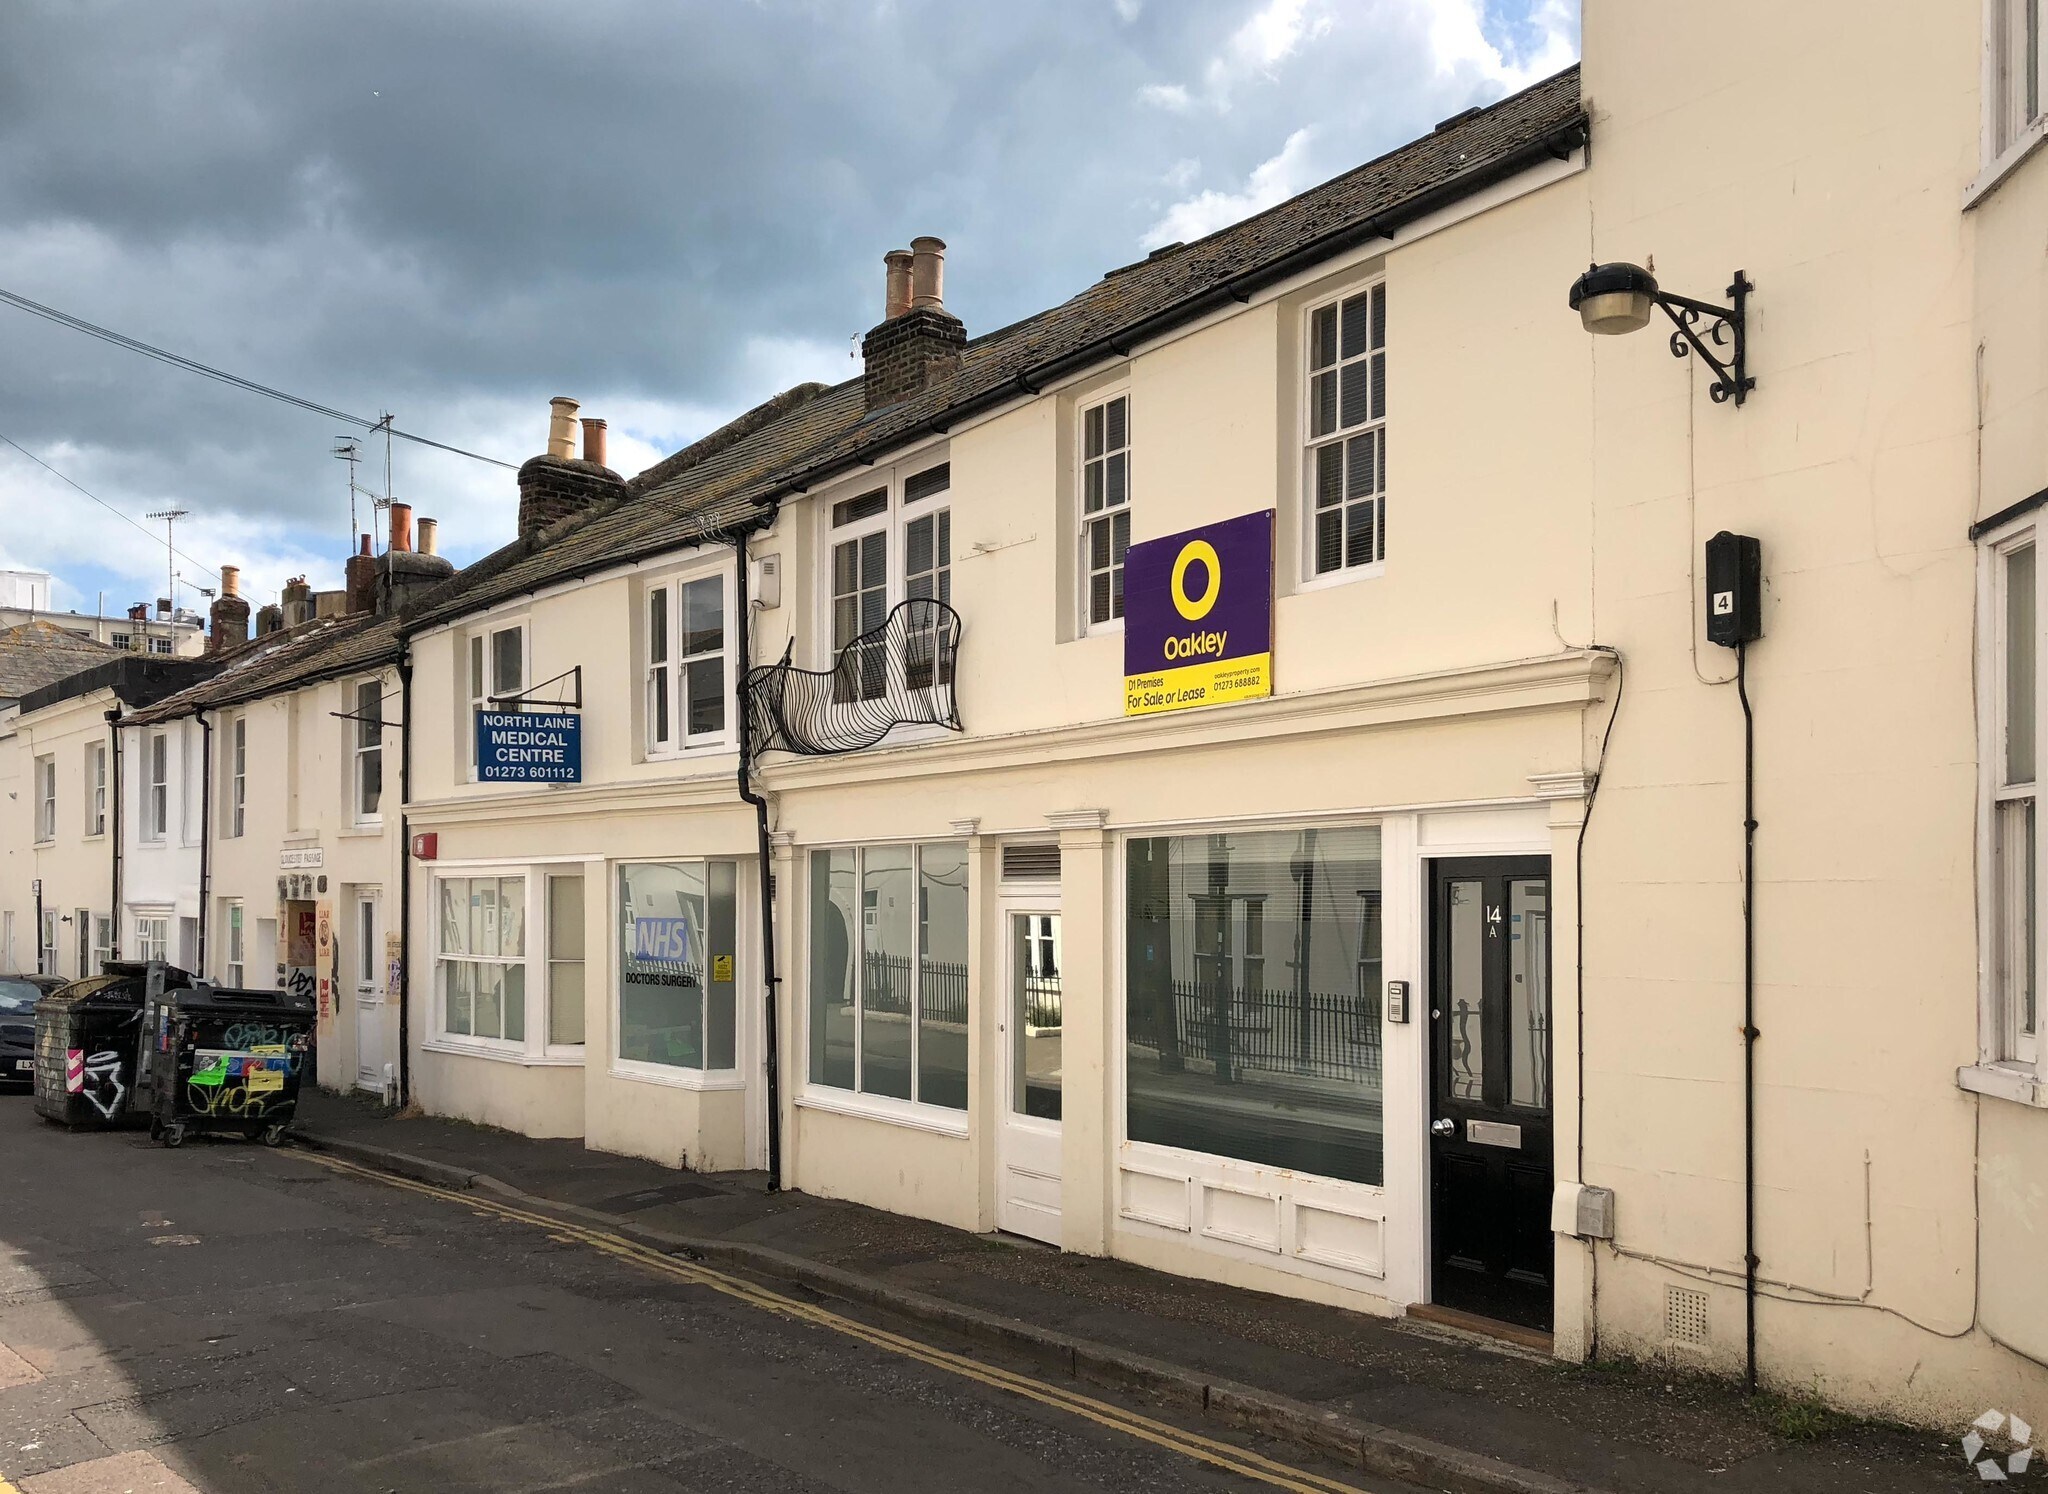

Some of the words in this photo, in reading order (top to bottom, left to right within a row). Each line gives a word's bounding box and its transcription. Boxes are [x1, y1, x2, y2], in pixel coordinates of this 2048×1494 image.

[1718, 595, 1729, 610] 4
[1164, 630, 1228, 660] Oakley
[1128, 679, 1136, 691] D1
[1136, 677, 1164, 689] Premises
[1213, 681, 1233, 691] 01273
[1234, 675, 1260, 688] 688882
[1127, 693, 1141, 709] For
[1143, 691, 1164, 706] Sale
[1165, 692, 1176, 703] or
[1177, 687, 1206, 702] Lease
[483, 714, 532, 728] NORTH
[535, 716, 575, 729] LAINE
[491, 730, 568, 747] MEDICAL
[495, 747, 564, 763] CENTRE
[485, 765, 526, 778] 01273
[529, 766, 575, 779] 601112
[1486, 904, 1502, 924] 14
[640, 920, 685, 958] NHS
[1488, 924, 1498, 938] A
[625, 972, 660, 985] DOCTORS
[661, 974, 697, 988] SURGERY
